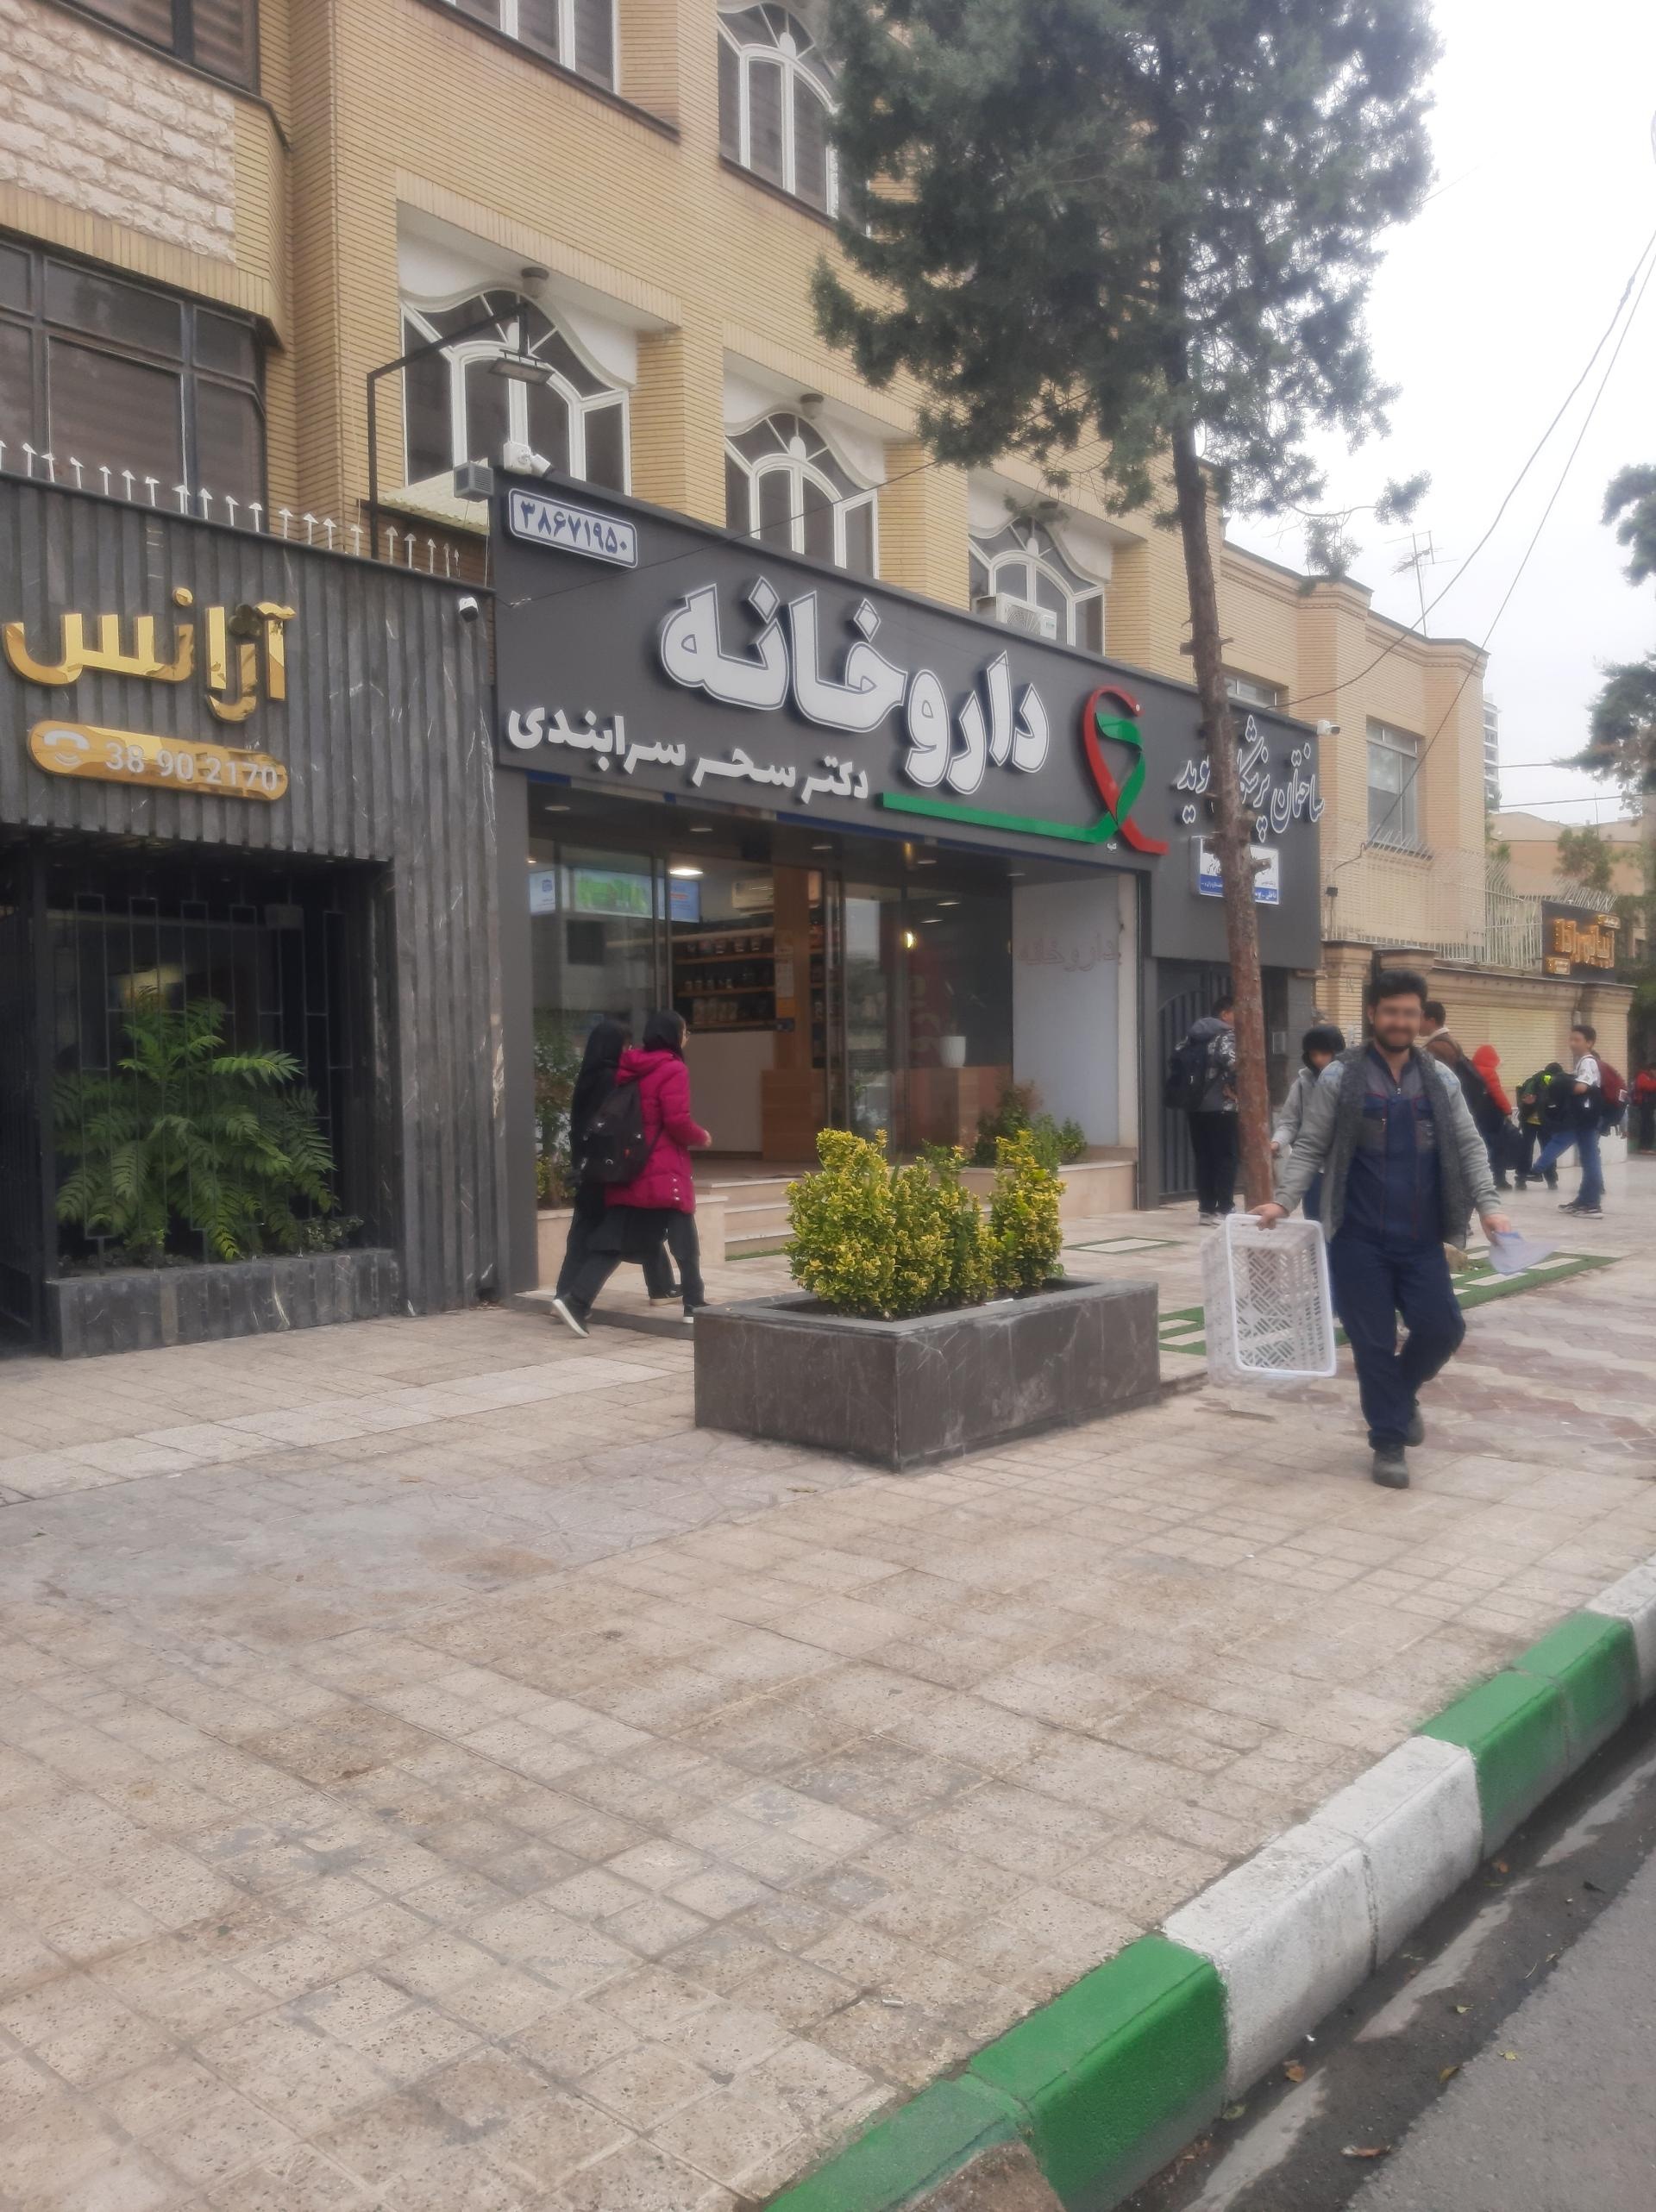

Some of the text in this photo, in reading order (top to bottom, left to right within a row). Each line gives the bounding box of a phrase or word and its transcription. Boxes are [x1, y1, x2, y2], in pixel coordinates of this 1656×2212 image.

[519, 498, 629, 555] ۳۸۶۷۱۹۵۰
[3, 586, 297, 724] آژانس
[660, 575, 1051, 796] داروخانه
[104, 741, 279, 793] 38 90 2170
[507, 705, 869, 805] دکتر سحر سرابندی
[1270, 742, 1326, 835] ساختمان
